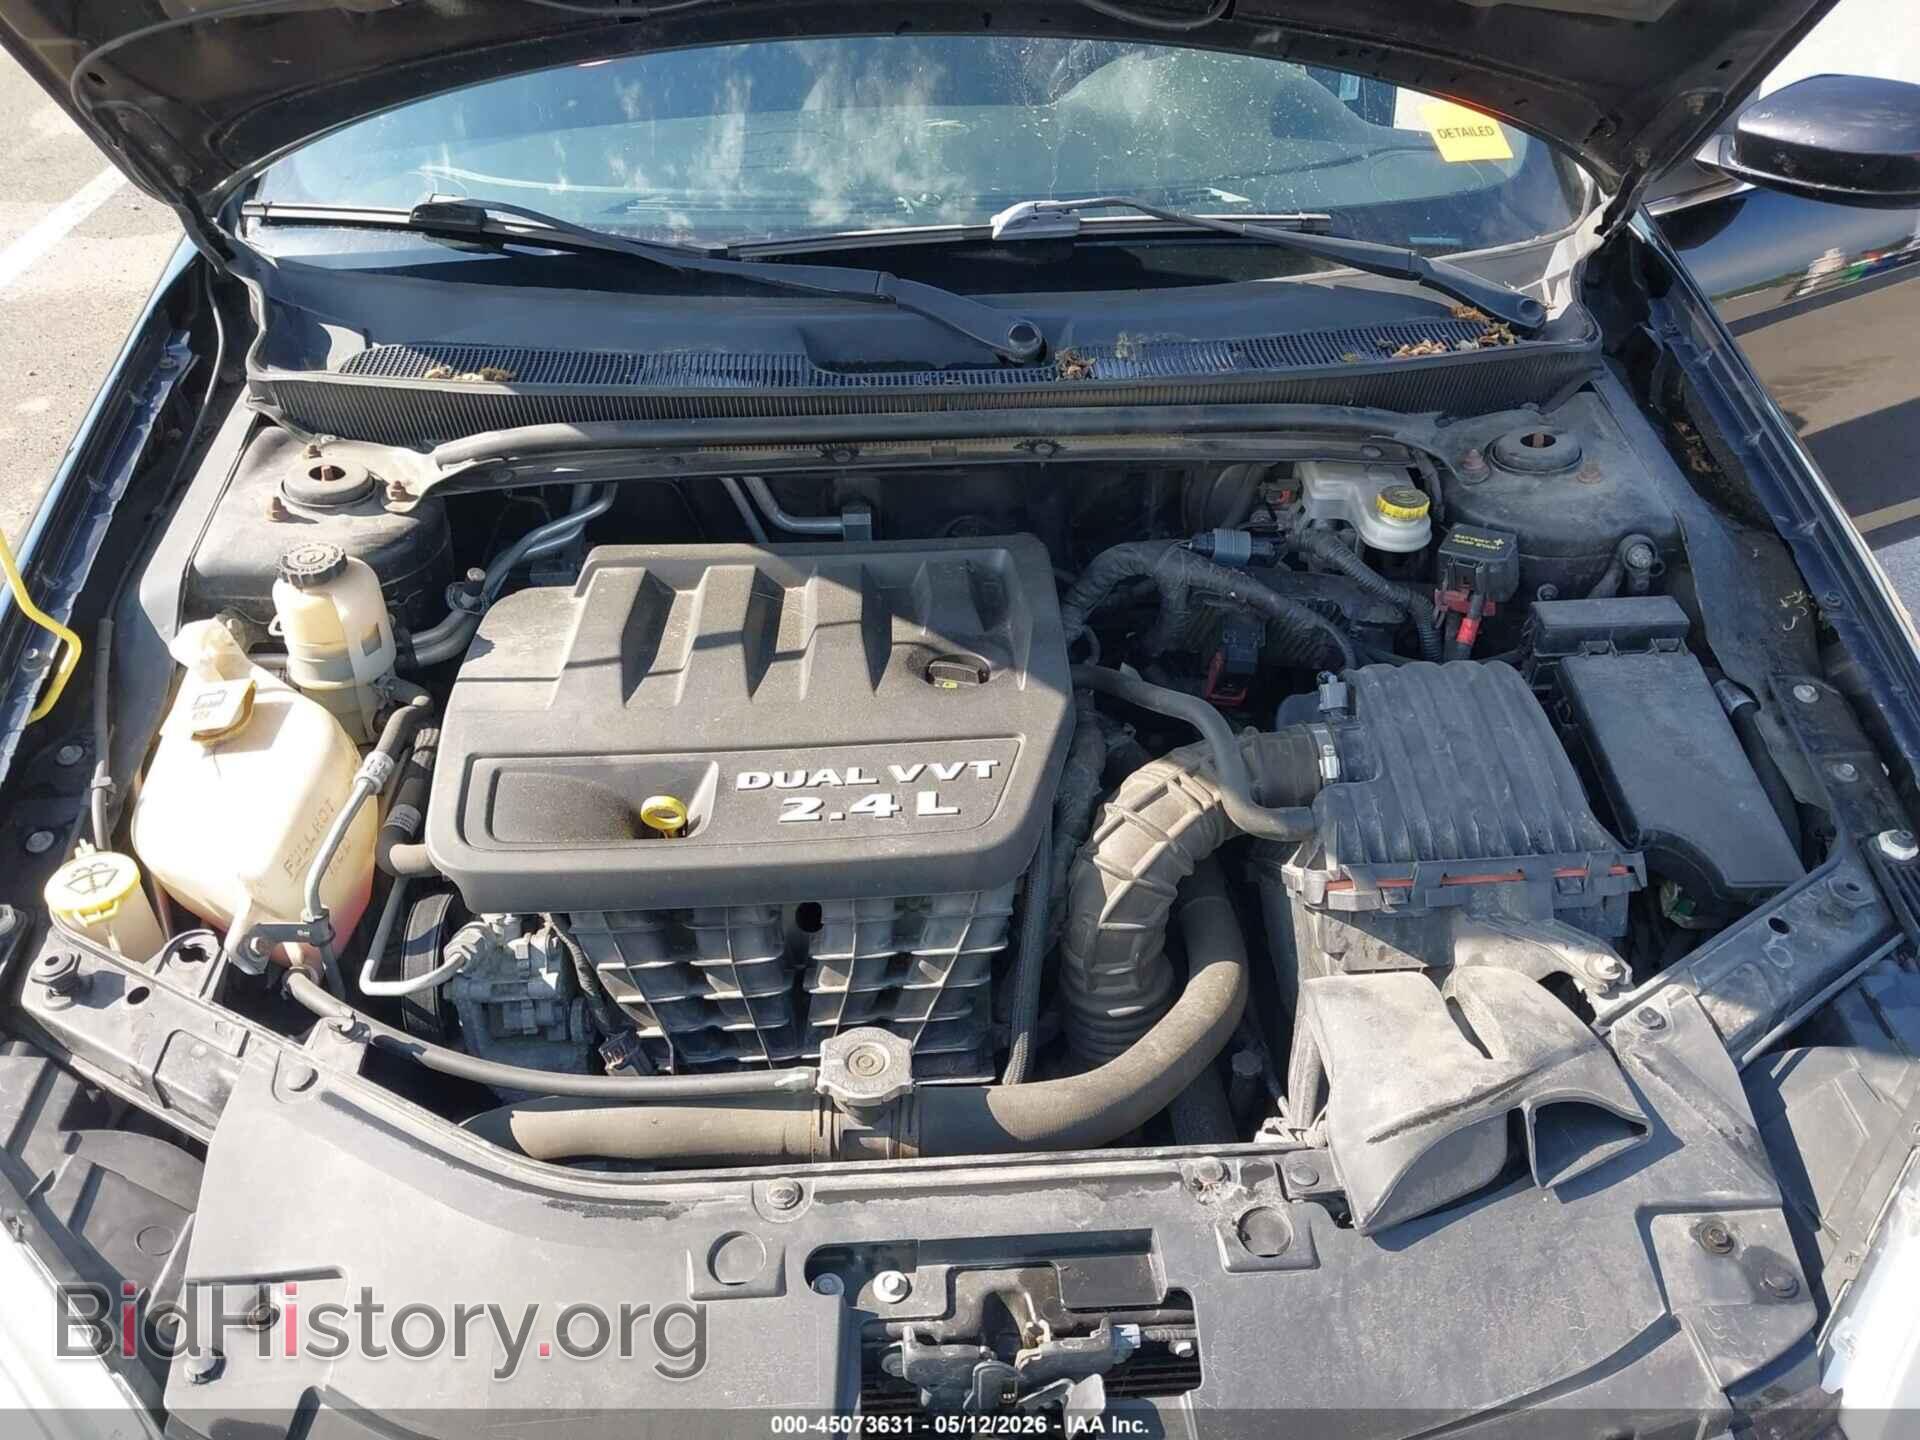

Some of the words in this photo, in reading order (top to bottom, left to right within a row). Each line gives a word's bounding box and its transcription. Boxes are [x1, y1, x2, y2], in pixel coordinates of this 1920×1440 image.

[1437, 125, 1495, 140] DETAILED
[736, 767, 880, 790] DUAL
[889, 760, 1001, 783] VVT
[779, 793, 903, 823] 2.4
[916, 791, 961, 817] L
